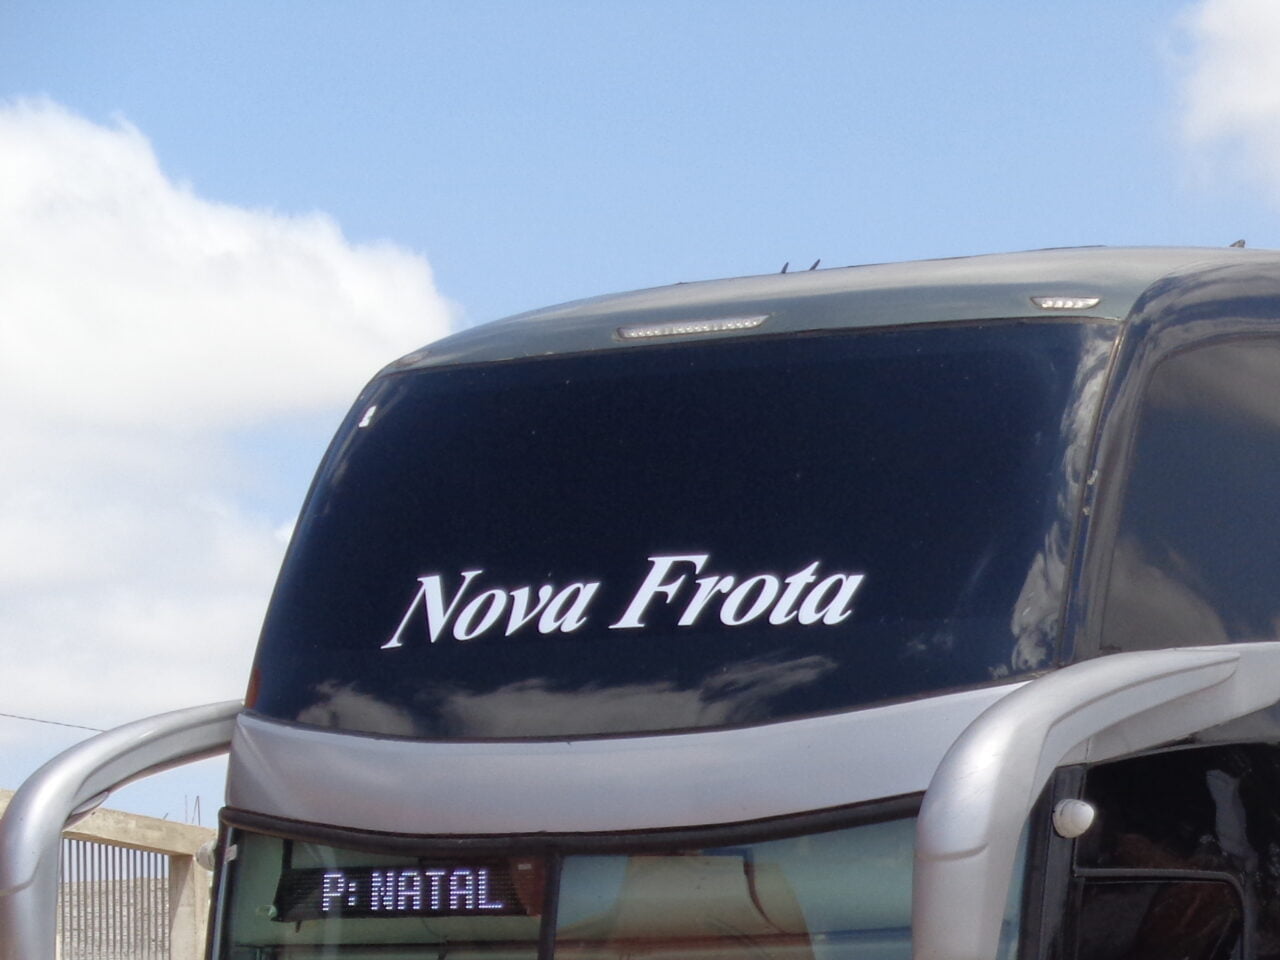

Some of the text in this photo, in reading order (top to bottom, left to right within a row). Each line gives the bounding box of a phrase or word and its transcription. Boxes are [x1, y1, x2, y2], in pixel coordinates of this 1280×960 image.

[381, 554, 864, 648] Nova Frota
[371, 870, 503, 911] NATAL
